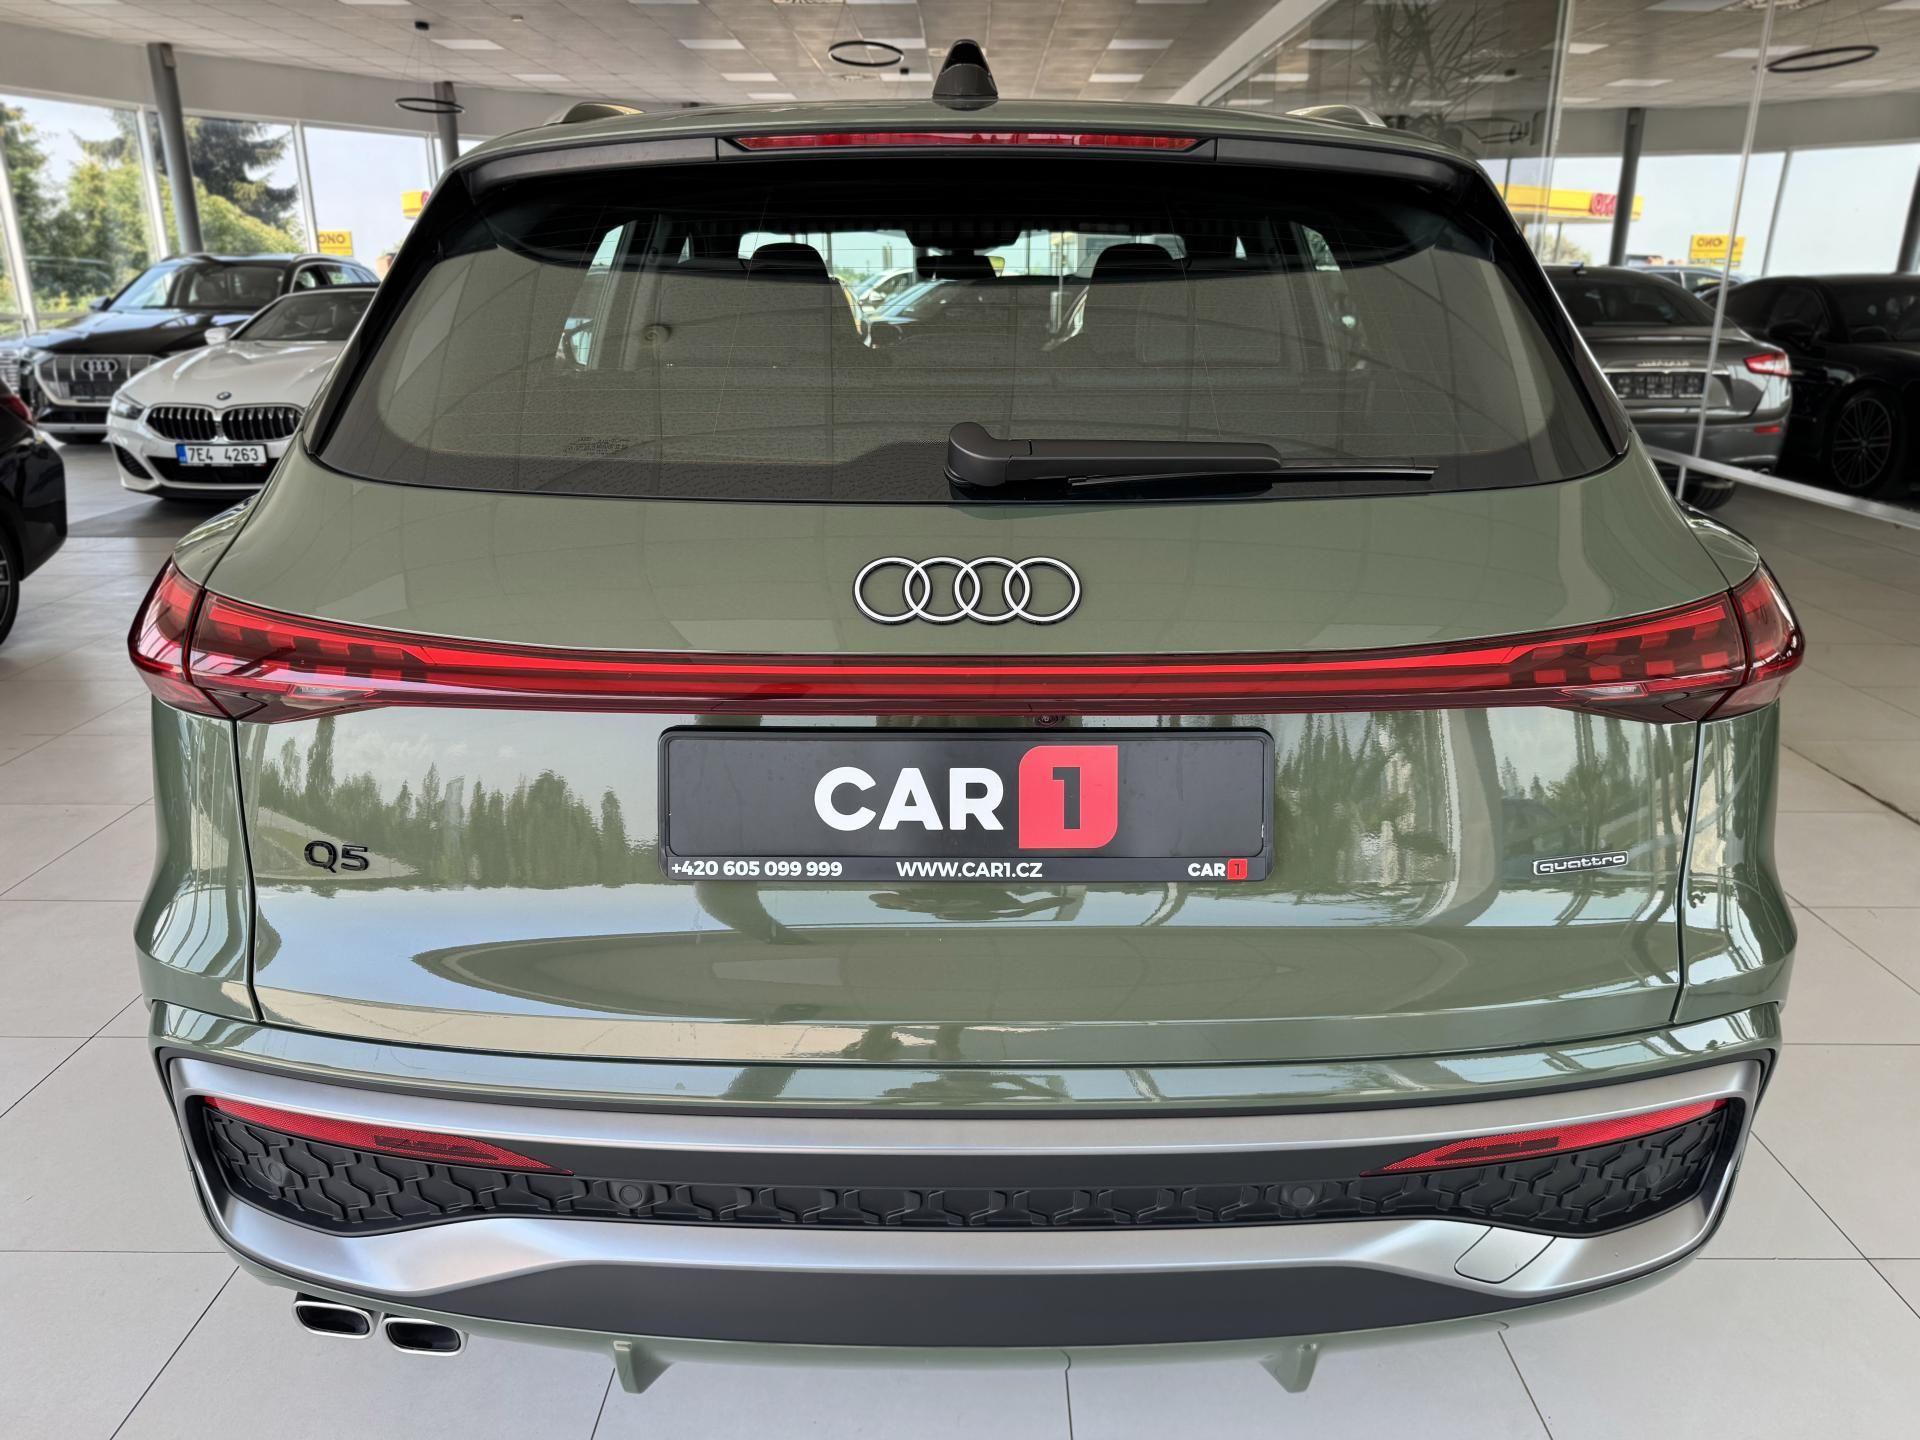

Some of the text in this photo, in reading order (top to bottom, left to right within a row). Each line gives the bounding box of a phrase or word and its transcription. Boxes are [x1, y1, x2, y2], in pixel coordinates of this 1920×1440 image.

[187, 447, 259, 462] 7E4 4263
[814, 766, 1080, 831] CAR 1
[304, 840, 369, 873] Q5
[1539, 854, 1626, 873] quattro
[671, 860, 843, 877] +420 605 099 999
[896, 861, 1043, 879] WWW.CAR1.CZ
[1187, 862, 1227, 877] CAR
